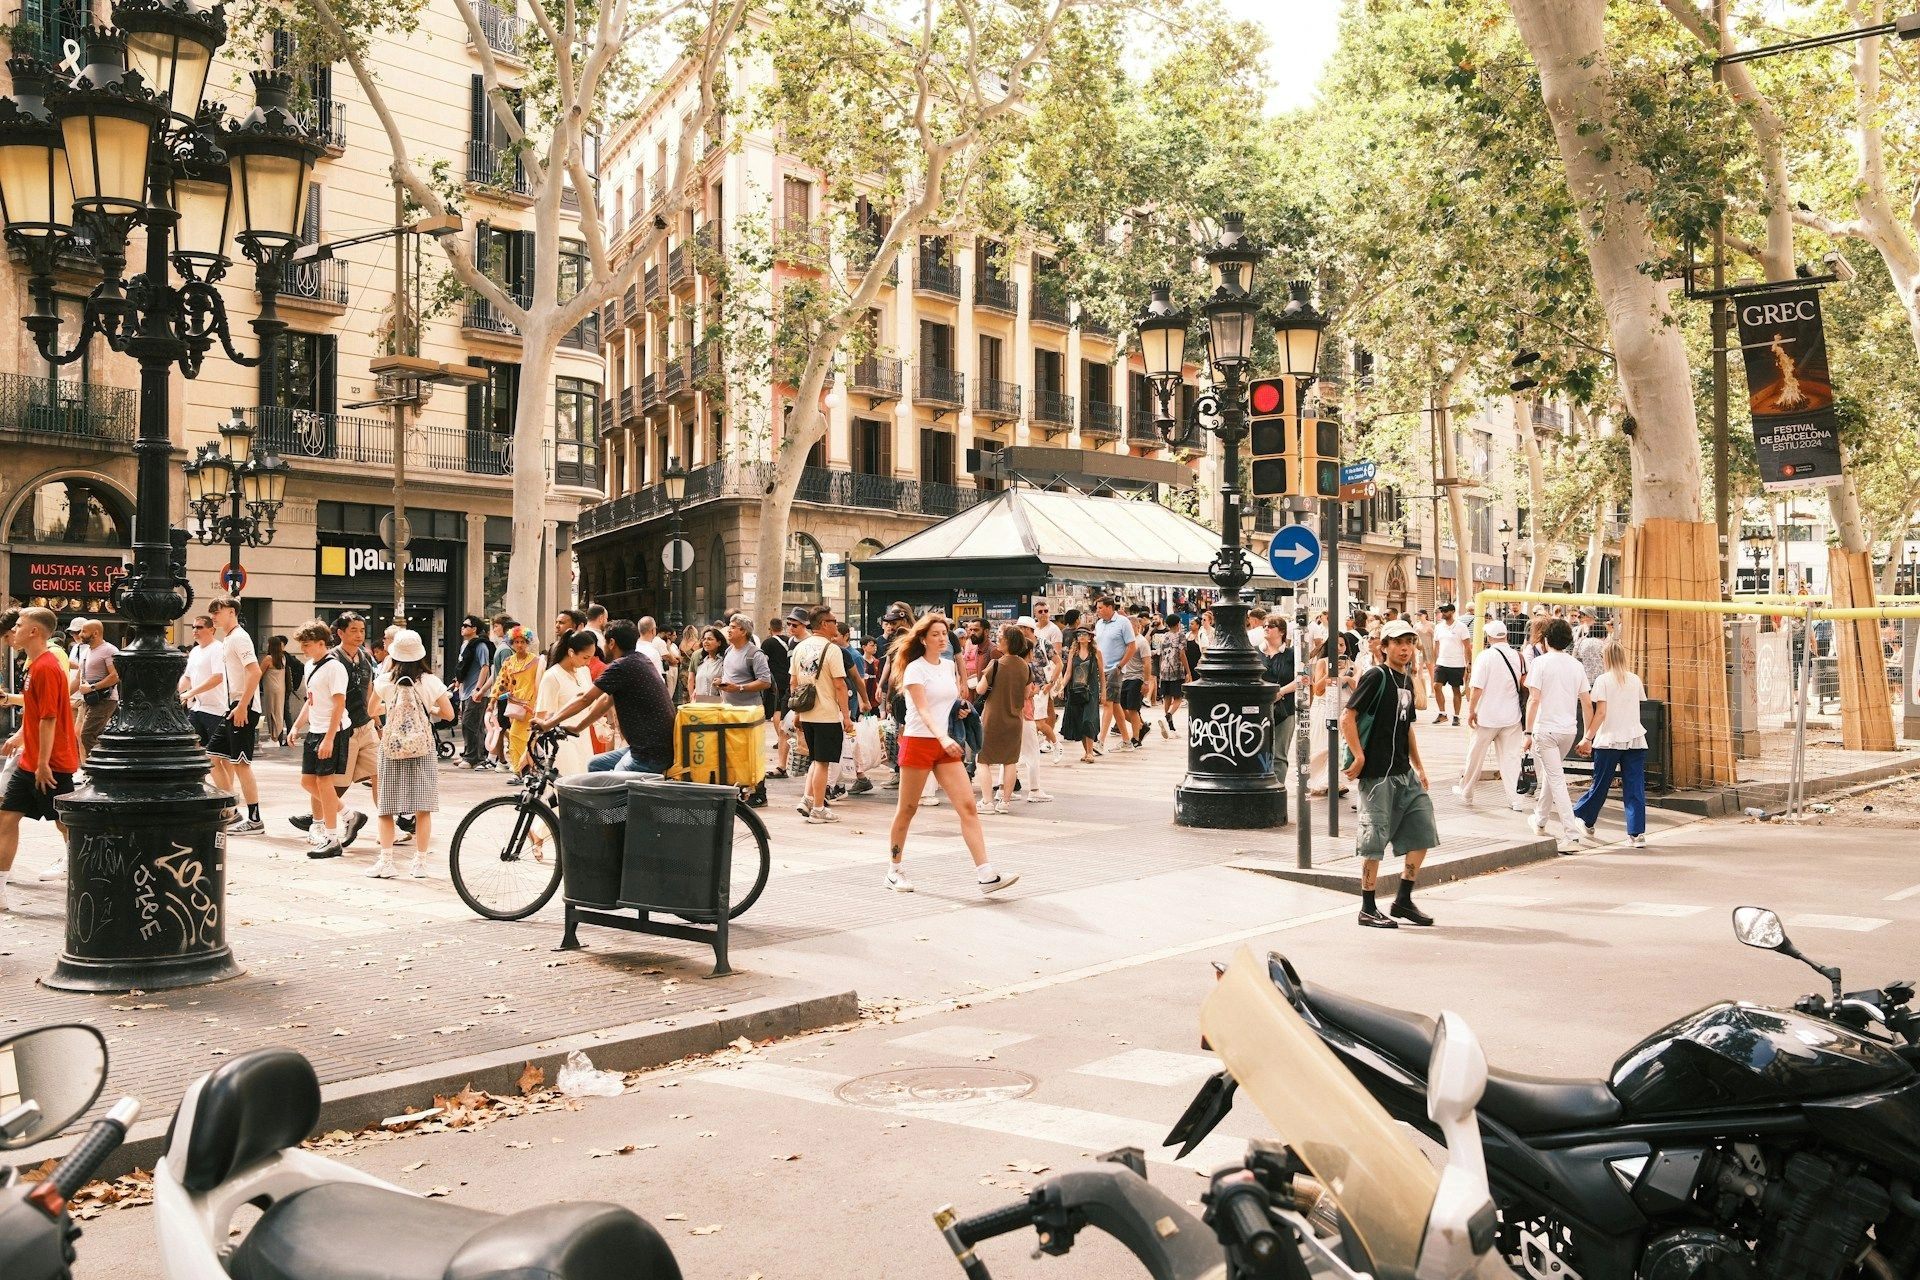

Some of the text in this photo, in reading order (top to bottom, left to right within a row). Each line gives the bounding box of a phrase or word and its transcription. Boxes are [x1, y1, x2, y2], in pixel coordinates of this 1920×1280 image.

[1742, 300, 1816, 326] GREC
[1773, 423, 1818, 434] FESTIVAL
[1760, 430, 1832, 445] DE BARCELONA
[1772, 439, 1822, 452] ESTIU 2024
[349, 547, 407, 577] pan
[416, 557, 448, 573] COMPANY
[32, 578, 111, 592] GEMÜSE KEB
[1309, 597, 1328, 608] AIKIN
[962, 607, 980, 616] ATM
